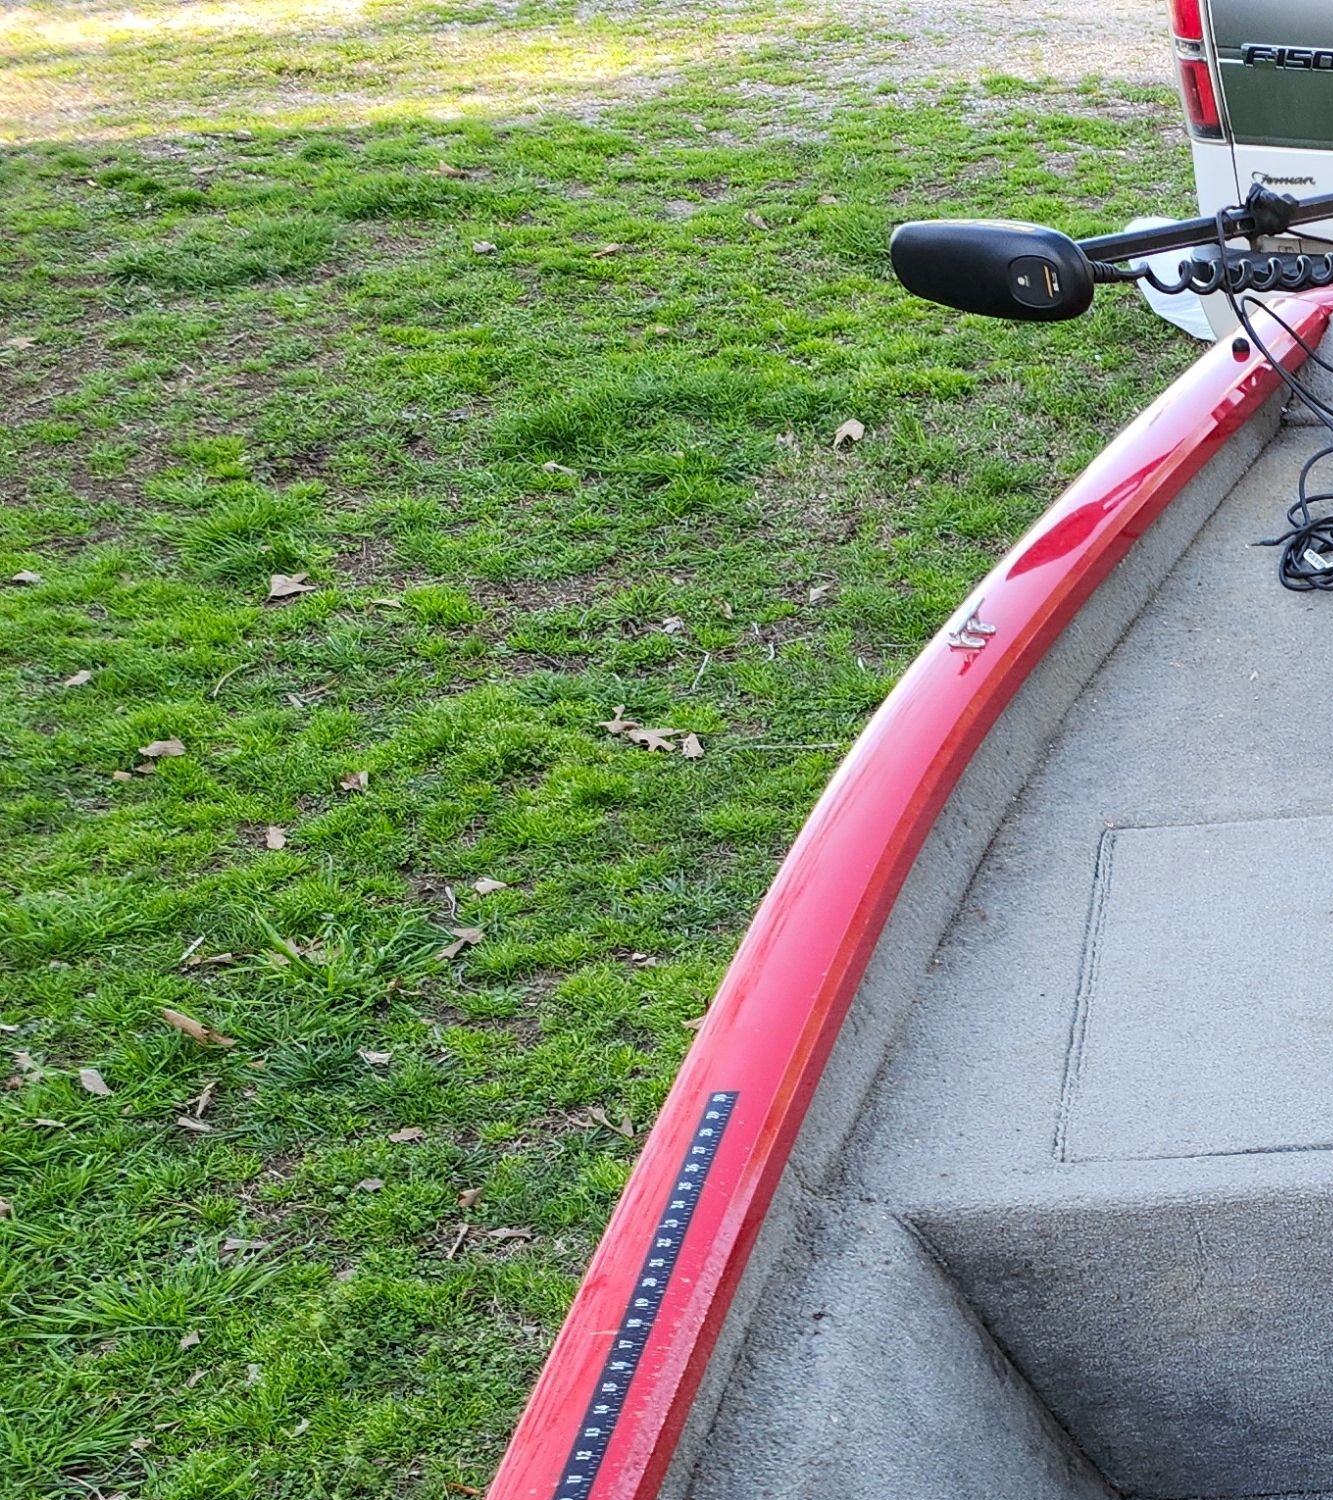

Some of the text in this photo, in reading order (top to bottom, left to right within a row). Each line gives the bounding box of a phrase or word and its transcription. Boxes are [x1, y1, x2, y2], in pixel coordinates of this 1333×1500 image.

[677, 1181, 693, 1191] 25
[670, 1200, 686, 1210] 24
[656, 1237, 672, 1248] 22
[649, 1258, 665, 1268] 21
[641, 1277, 658, 1287] 20
[634, 1297, 649, 1307] 19
[626, 1318, 643, 1328] 18
[618, 1339, 634, 1349] 17
[601, 1382, 618, 1393] 15
[593, 1404, 610, 1415] 14
[584, 1427, 600, 1438] 13
[575, 1450, 592, 1461] 12
[566, 1475, 583, 1484] 11
